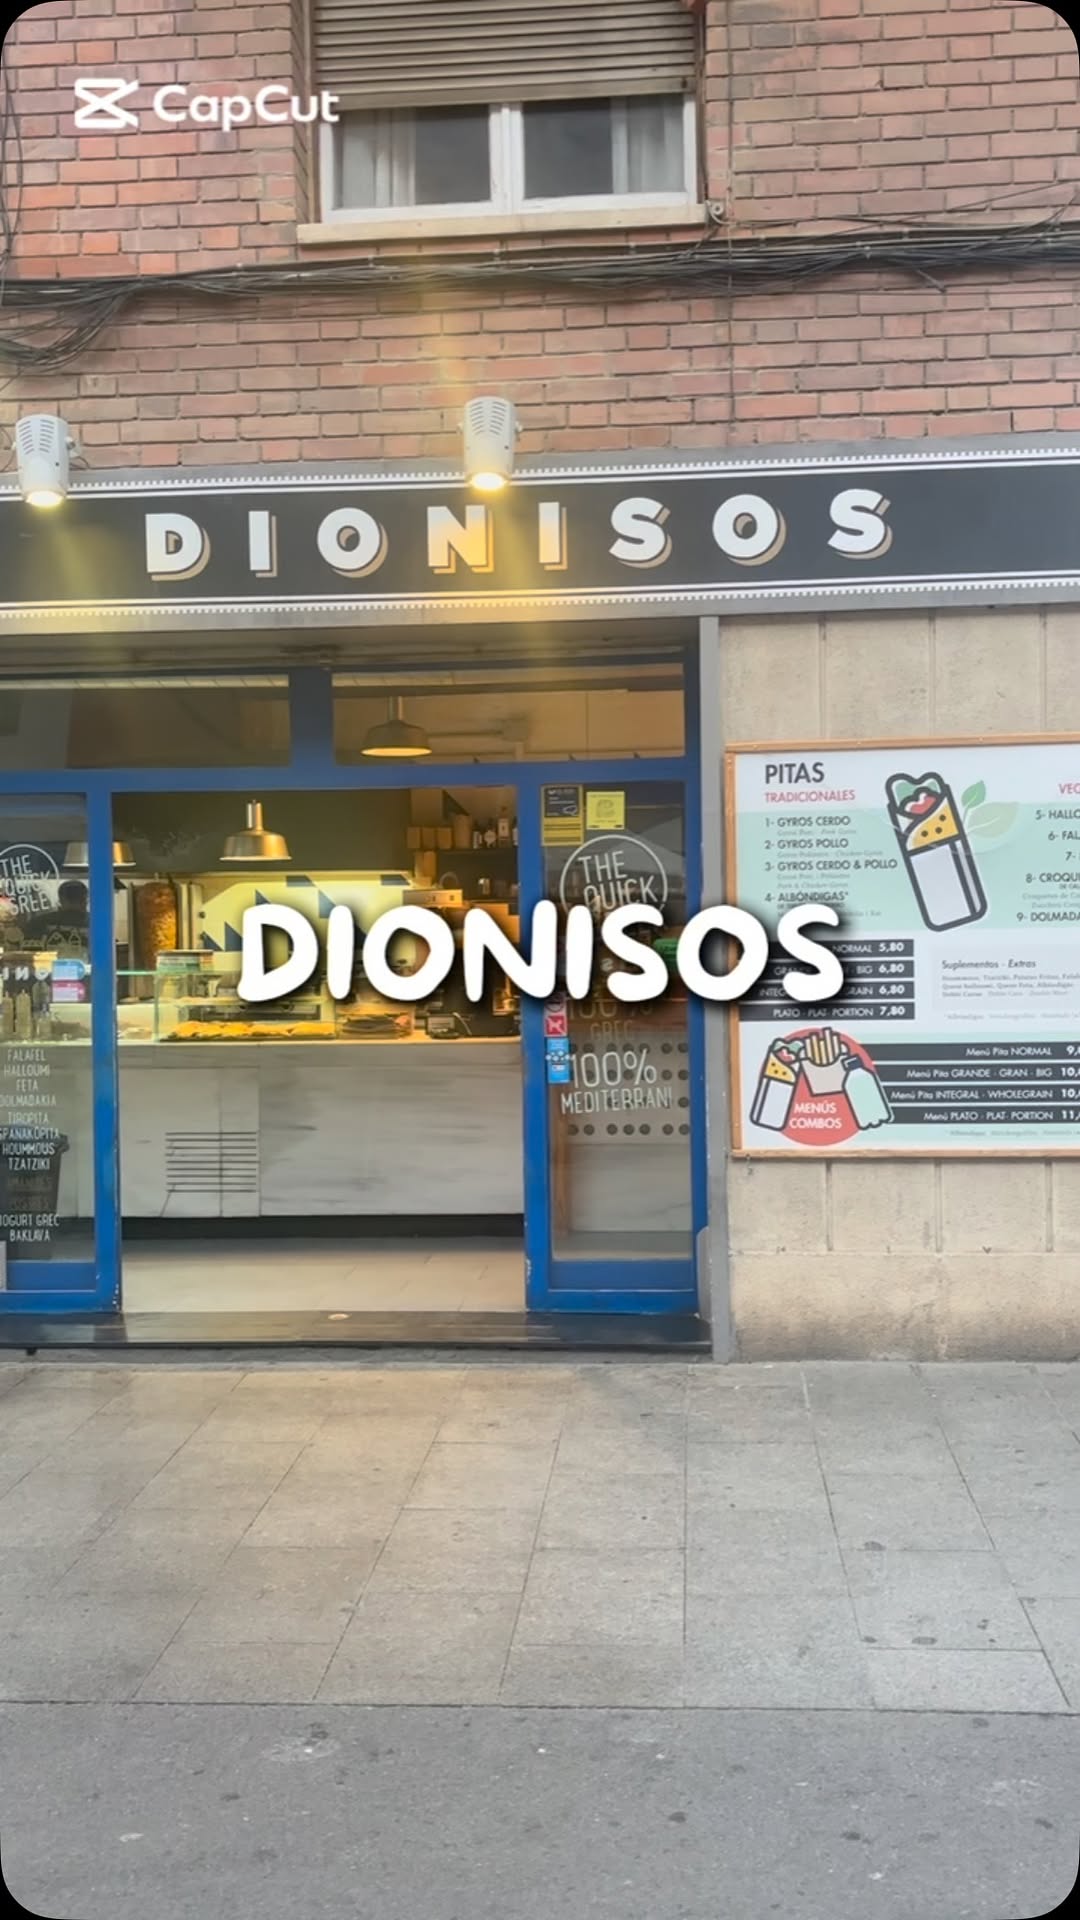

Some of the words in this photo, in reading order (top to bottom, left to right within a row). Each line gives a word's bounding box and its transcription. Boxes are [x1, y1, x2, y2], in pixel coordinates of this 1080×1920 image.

[145, 488, 892, 582] DIONISOS
[765, 762, 825, 785] PITAS
[765, 789, 856, 804] TRADICIONALES
[777, 817, 813, 828] GYROS
[816, 815, 851, 827] CERDO
[777, 839, 813, 850] GYROS
[816, 838, 849, 848] POLLO
[0, 854, 32, 878] THE
[578, 850, 628, 884] THE
[777, 860, 813, 871] GYROS
[816, 859, 850, 871] CERDO
[853, 860, 861, 870] &
[864, 859, 898, 869] POLLO
[1039, 872, 1080, 883] CROQU
[583, 875, 658, 911] QUICK
[832, 943, 872, 954] NORMAL
[879, 942, 905, 953] 5,80
[856, 964, 873, 974] BIG
[879, 963, 905, 975] 6,80
[942, 959, 999, 971] Suplementos
[1008, 958, 1036, 968] Extras
[879, 984, 905, 996] 6,80
[773, 1007, 800, 1018] PLATO
[808, 1007, 827, 1018] PLAT
[832, 1006, 874, 1018] PORTION
[880, 1005, 906, 1017] 7,80
[7, 1048, 46, 1061] FALAFEL
[966, 1047, 990, 1057] Menú
[992, 1046, 1009, 1057] Pita
[1011, 1045, 1052, 1056] NORMAL
[4, 1063, 50, 1077] HALLOUMI
[569, 1047, 657, 1089] 100%
[906, 1068, 931, 1079] Menú
[933, 1068, 949, 1078] Pita
[951, 1067, 990, 1078] GRANDE
[999, 1067, 1028, 1077] GRAN
[1036, 1066, 1053, 1077] BIG
[16, 1079, 39, 1092] FETA
[891, 1089, 915, 1100] Menú
[918, 1089, 934, 1100] Pita
[936, 1088, 980, 1099] INTEGRAL
[988, 1087, 1053, 1099] WHOLEGRAIN
[561, 1086, 673, 1115] MEDITERRANI
[794, 1100, 838, 1114] MENÚS
[8, 1111, 49, 1125] TIROPITA
[924, 1111, 949, 1121] Menú
[950, 1110, 979, 1121] PLATO
[986, 1110, 1006, 1120] PLAT
[1011, 1109, 1053, 1120] PORTION
[790, 1117, 843, 1129] COMBOS
[2, 1142, 56, 1156] HOUMMOUS
[8, 1157, 50, 1171] TZATZIKI
[36, 1213, 60, 1227] GREC
[9, 1229, 51, 1242] BAKLAVA
